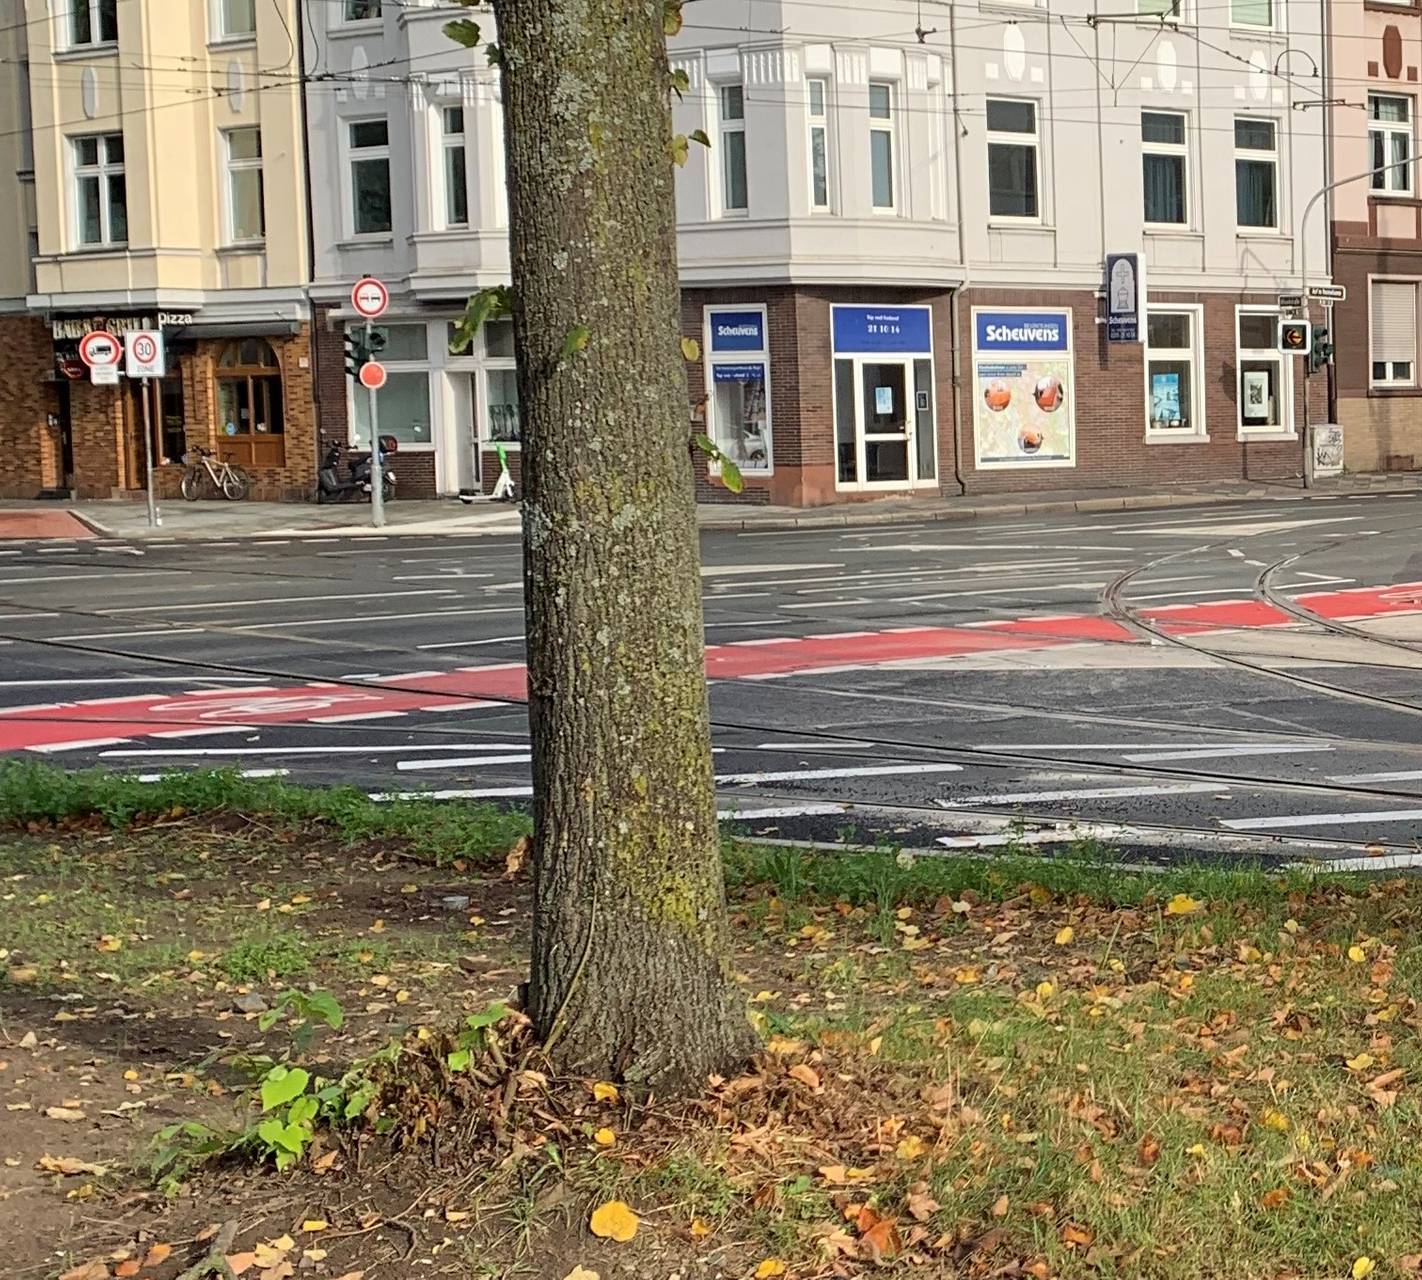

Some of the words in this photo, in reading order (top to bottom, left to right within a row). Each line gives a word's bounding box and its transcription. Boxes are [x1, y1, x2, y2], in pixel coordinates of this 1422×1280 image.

[718, 325, 759, 336] Scheuvens
[985, 324, 1060, 342] Scheuvens
[136, 342, 152, 356] 30
